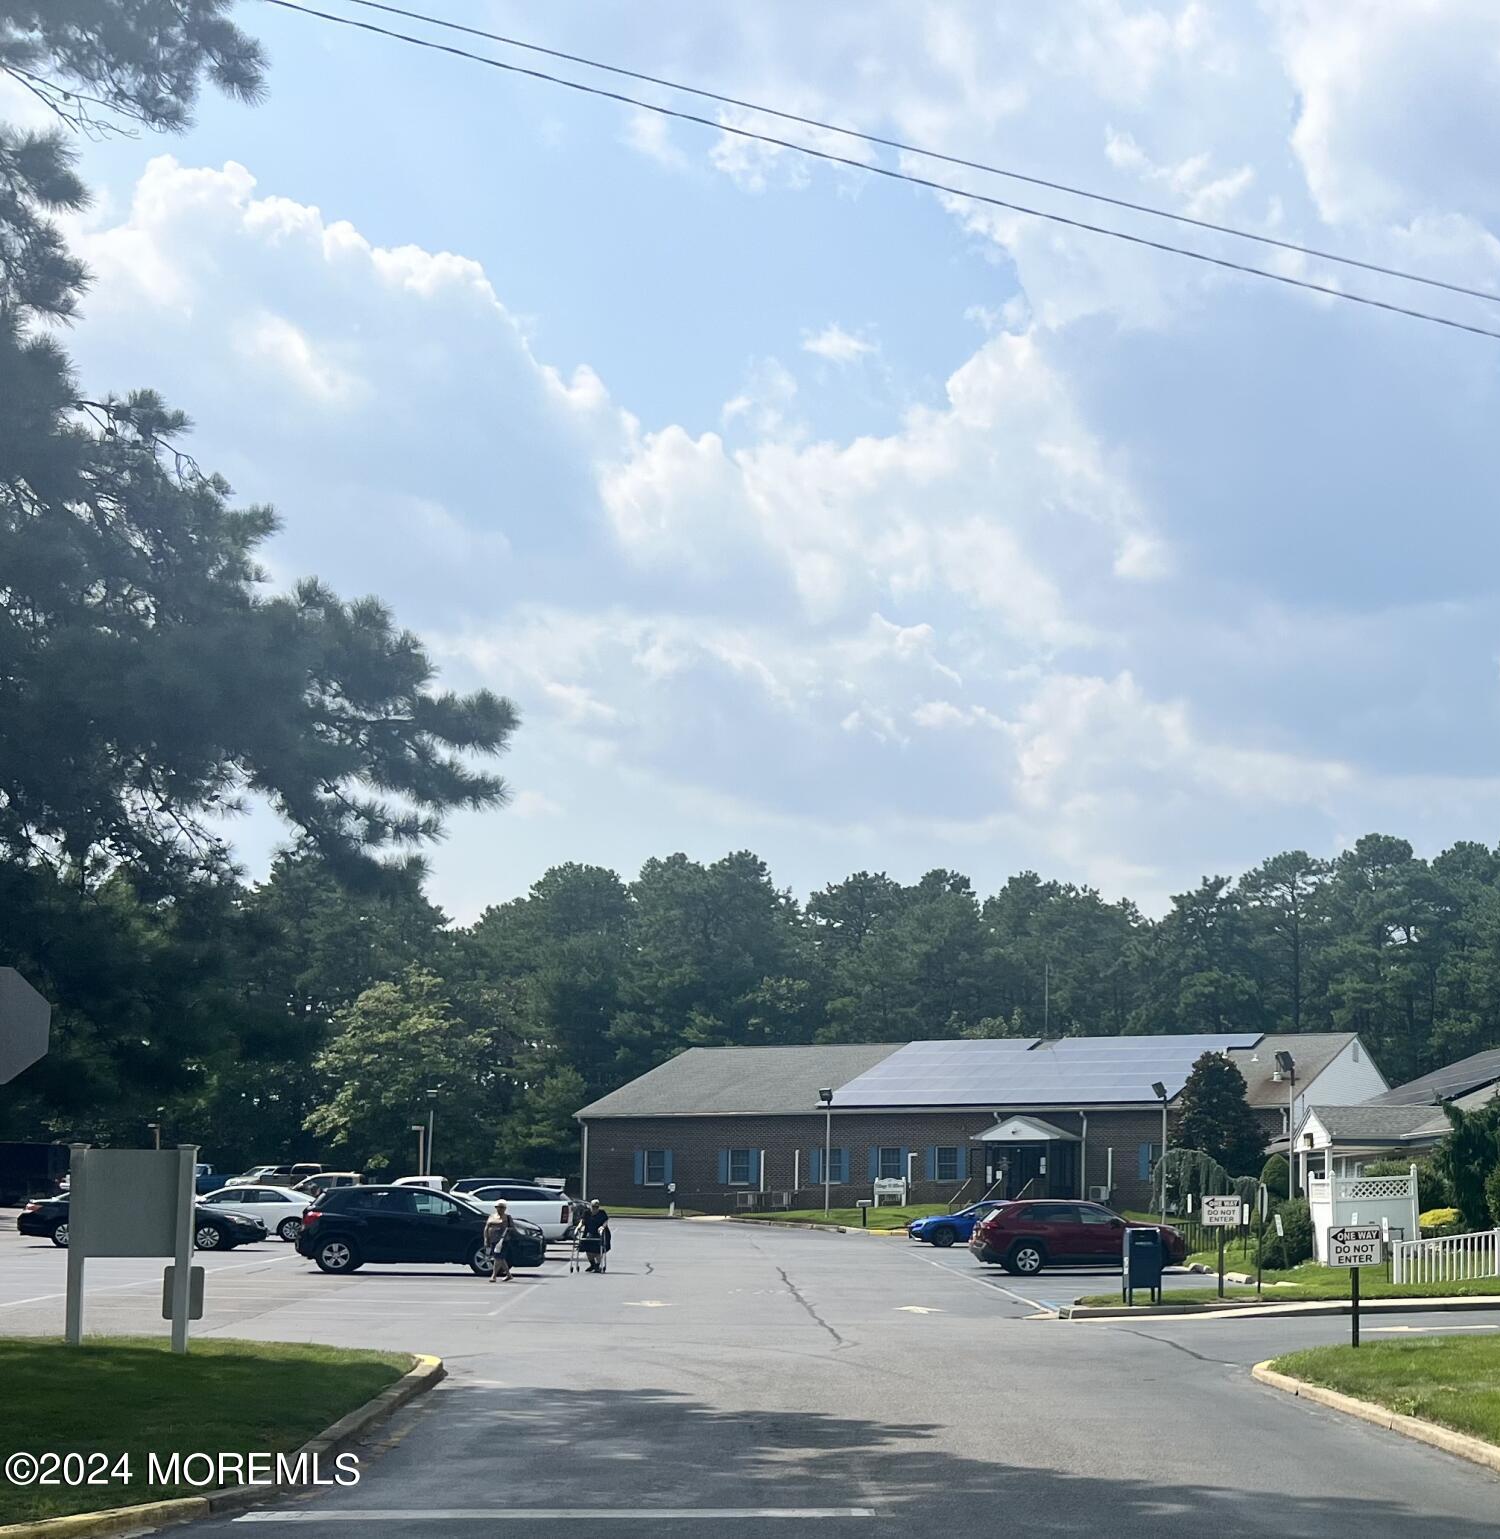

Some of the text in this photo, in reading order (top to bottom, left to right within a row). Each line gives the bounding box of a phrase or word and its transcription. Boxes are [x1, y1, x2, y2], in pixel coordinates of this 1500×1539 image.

[1337, 1230, 1377, 1241] ONE WAY
[1335, 1244, 1375, 1254] DO NOT
[1338, 1254, 1373, 1264] ENTER
